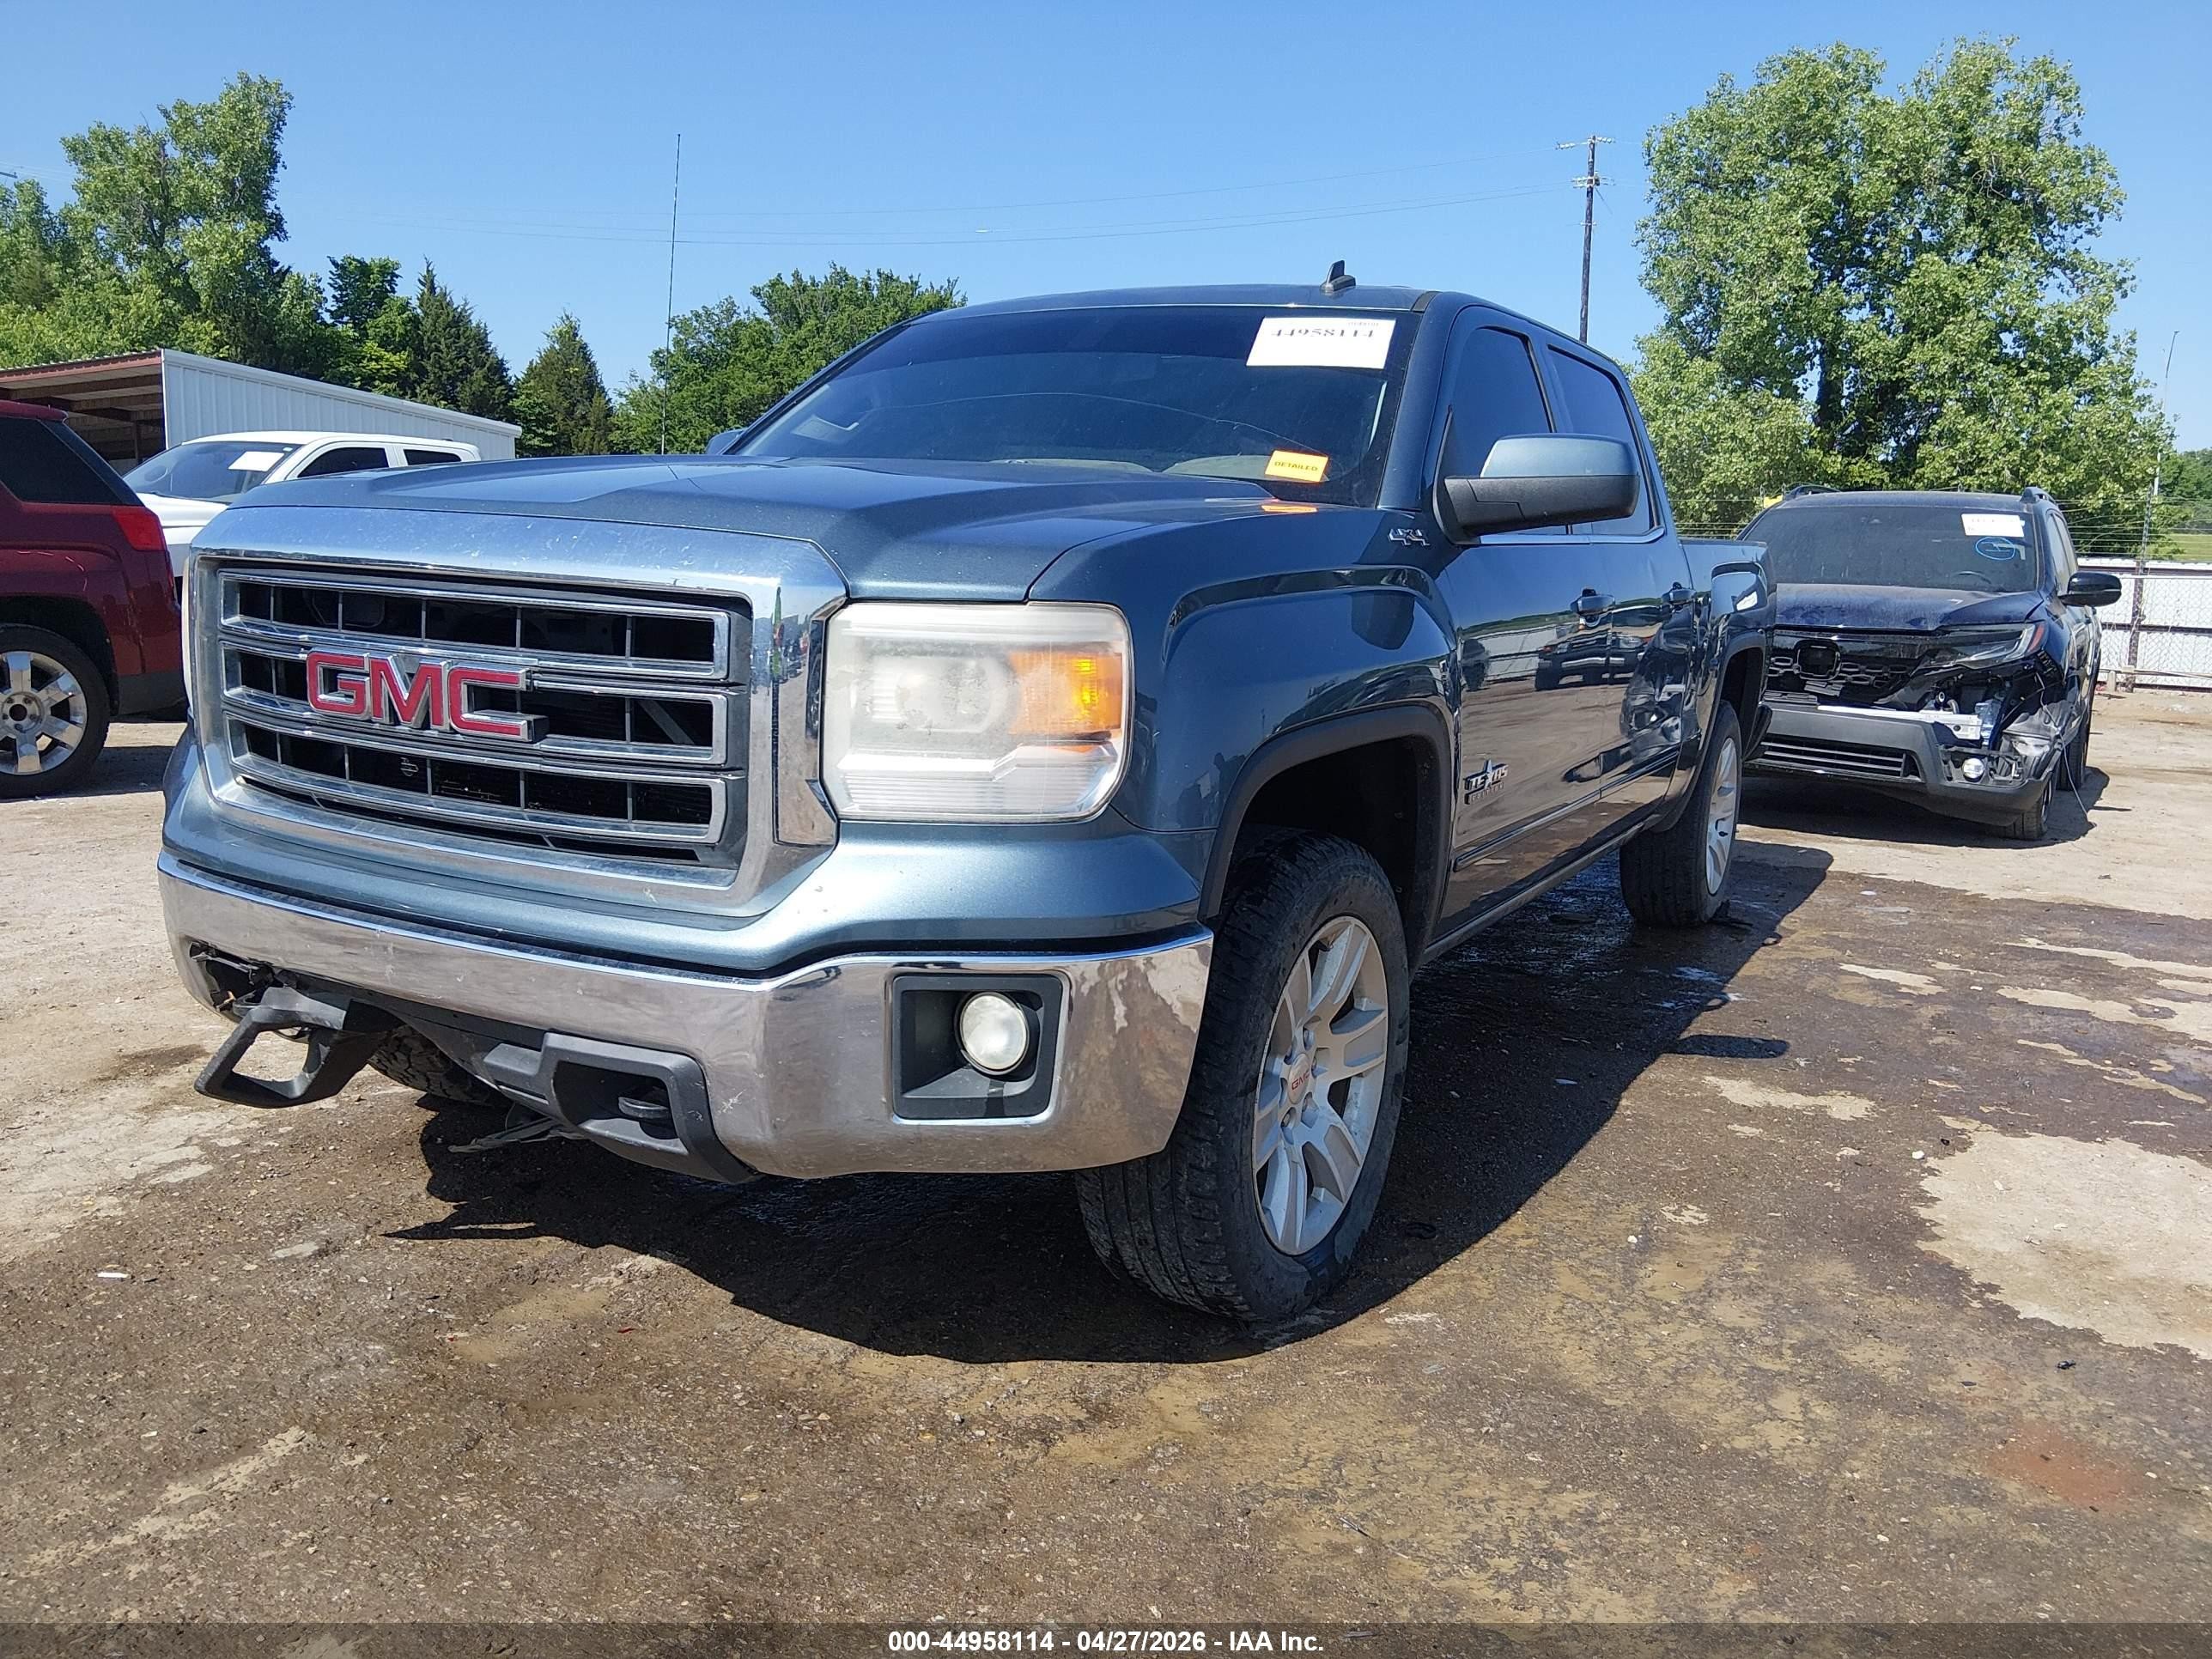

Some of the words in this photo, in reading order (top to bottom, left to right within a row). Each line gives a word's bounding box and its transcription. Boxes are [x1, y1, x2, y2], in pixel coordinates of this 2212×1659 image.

[1274, 461, 1318, 471] DETAILED
[307, 647, 541, 742] GMC
[1467, 761, 1510, 790] TEXAS
[1291, 1070, 1310, 1091] GMC
